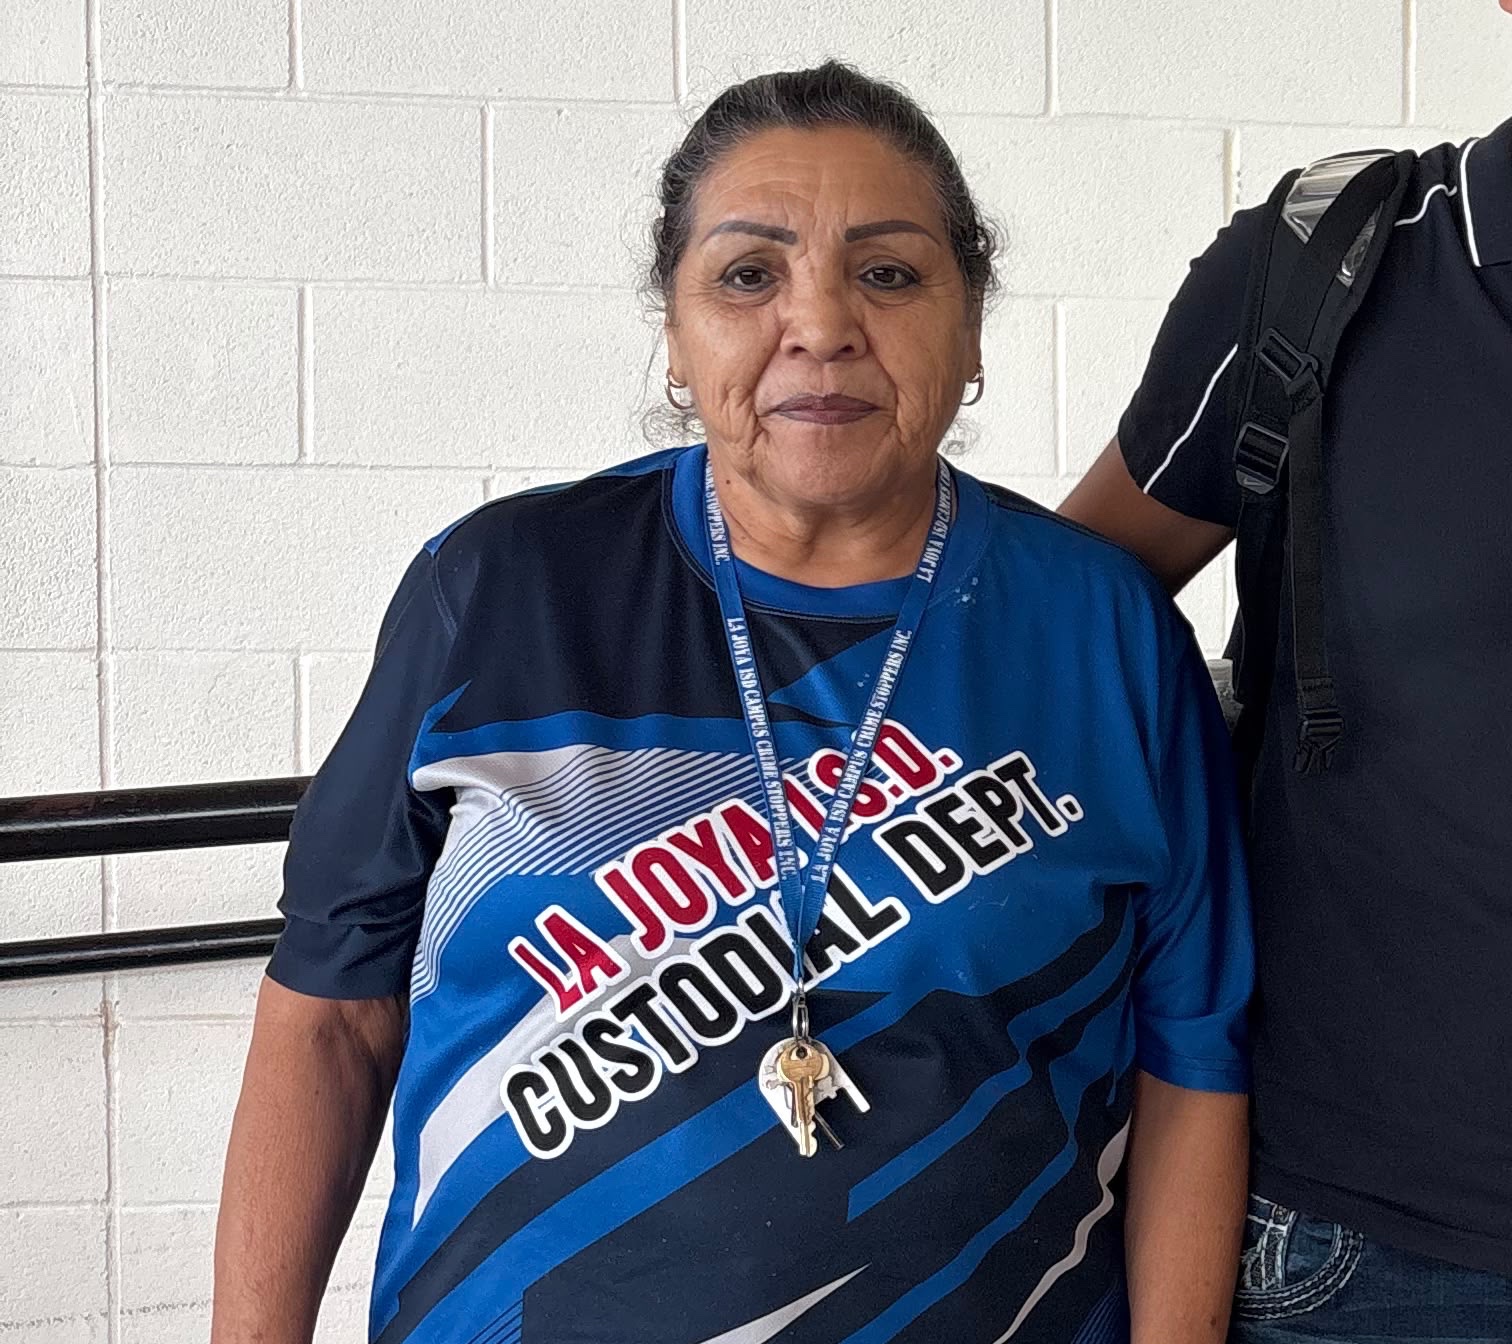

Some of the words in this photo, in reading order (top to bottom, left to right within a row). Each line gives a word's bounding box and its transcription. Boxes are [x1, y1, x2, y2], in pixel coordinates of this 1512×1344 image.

[921, 539, 945, 568] JOYA
[916, 566, 936, 584] LA
[726, 617, 745, 633] LA
[731, 632, 753, 666] JOYA
[738, 667, 757, 689] ISD
[869, 650, 905, 710] STOPPERS
[743, 690, 770, 738] CAMPUS
[855, 708, 883, 749] CRIME
[755, 739, 779, 780] CRIME
[838, 747, 869, 800] CAMPUS
[765, 780, 794, 848] STOPPERS
[828, 799, 849, 823] ISD
[818, 826, 841, 862] JOYA
[810, 862, 830, 884] LA
[512, 910, 624, 1014] LA
[602, 803, 777, 953] JOYA
[505, 868, 902, 1153] CUSTODIAL
[880, 758, 1082, 897] DEPT.
